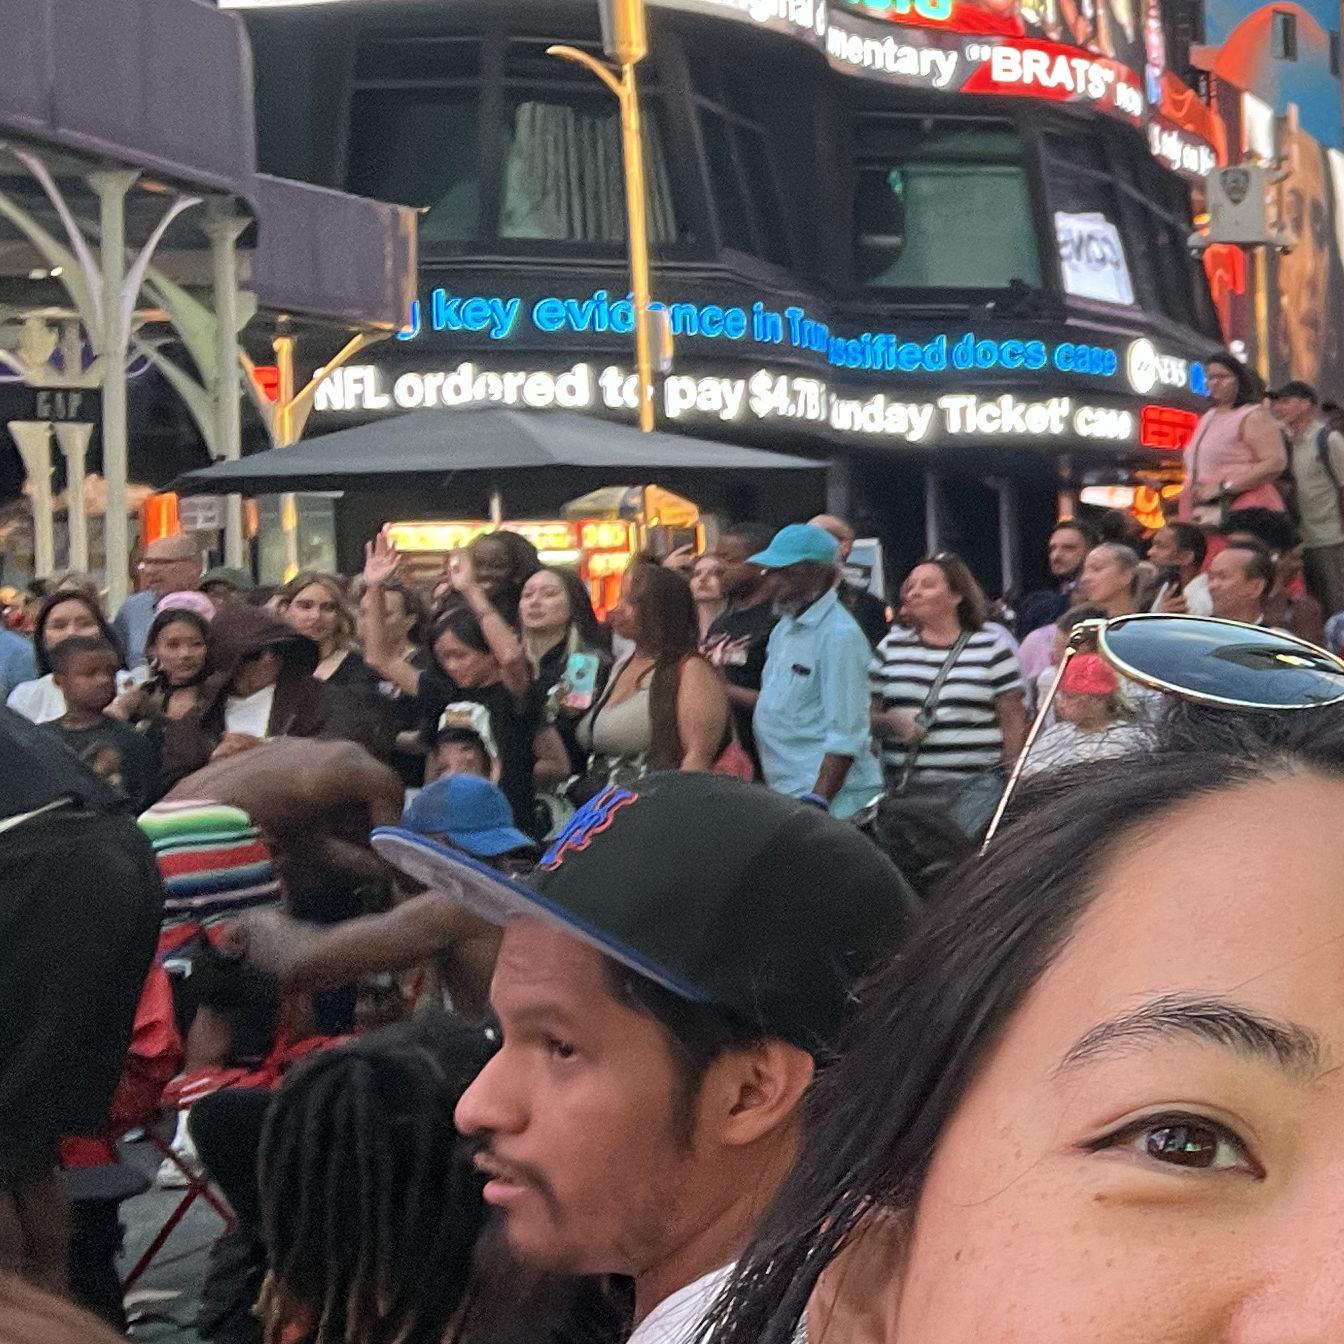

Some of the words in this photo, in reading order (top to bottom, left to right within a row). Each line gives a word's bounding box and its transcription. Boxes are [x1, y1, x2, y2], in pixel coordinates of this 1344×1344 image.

[430, 288, 521, 340] key
[532, 290, 748, 340] evidnce
[752, 300, 784, 344] in
[952, 331, 1047, 370] docs
[313, 362, 390, 412] NFL
[394, 361, 590, 408] ordered
[663, 374, 746, 421] pay
